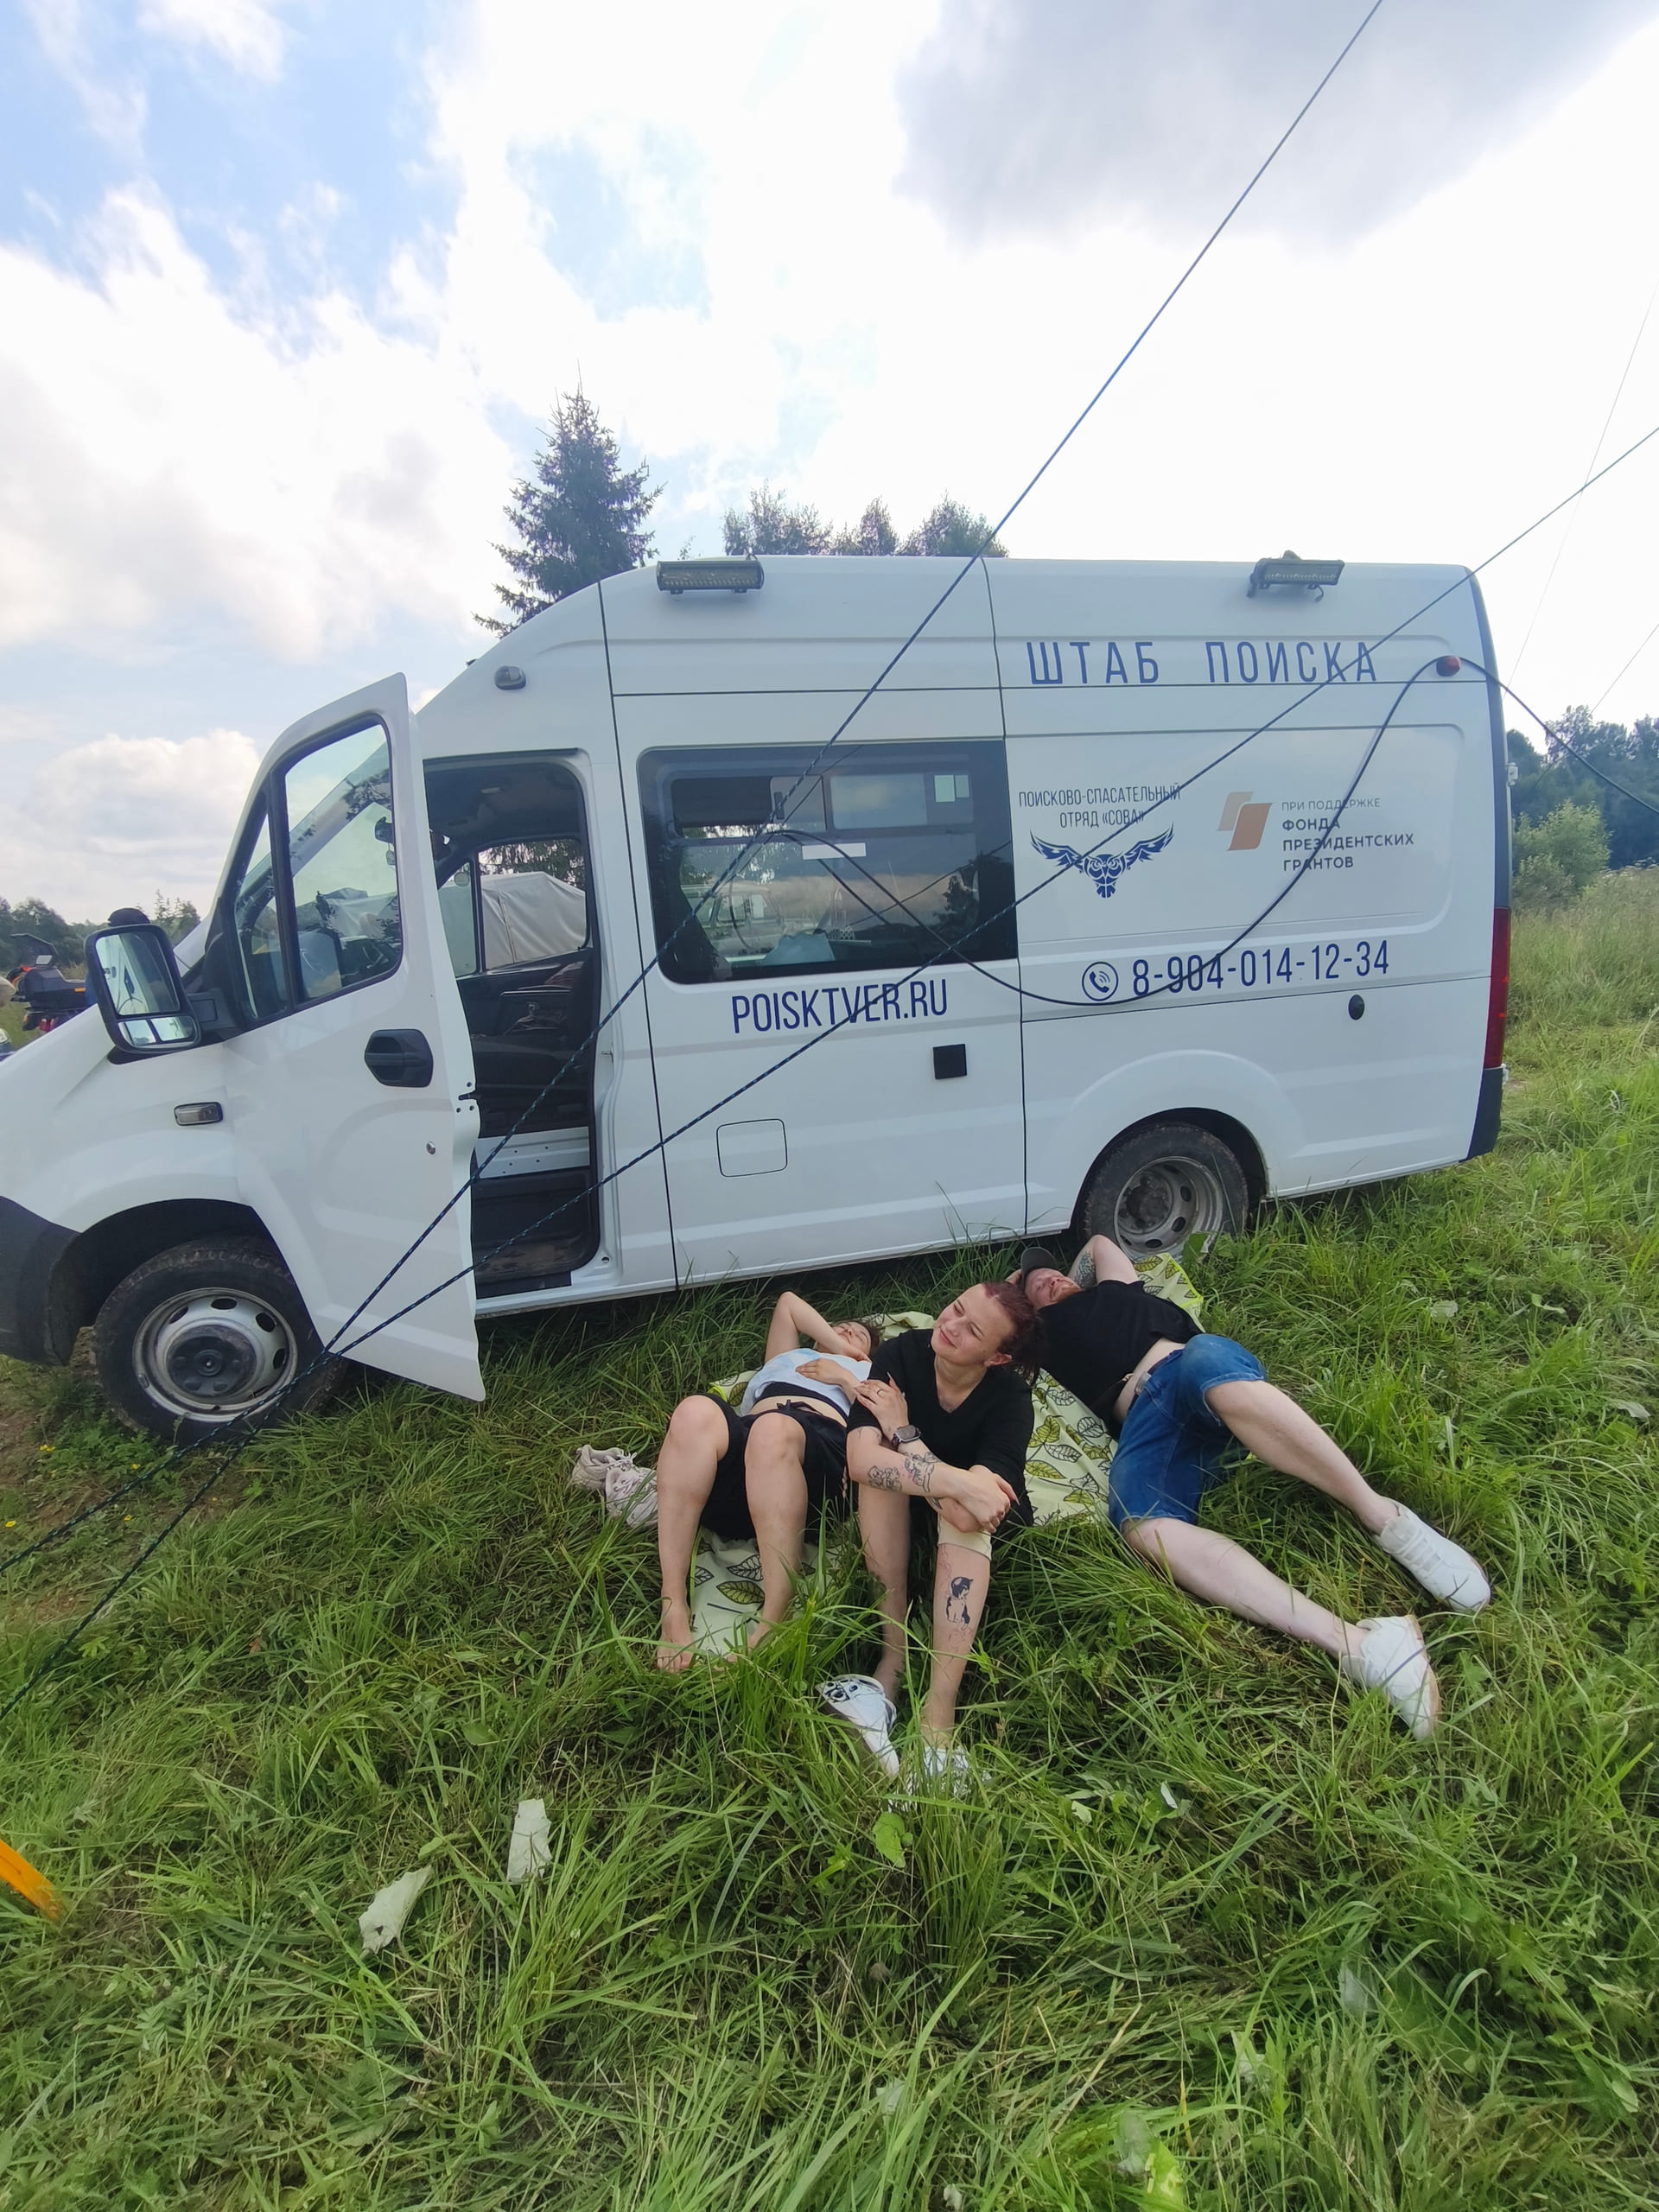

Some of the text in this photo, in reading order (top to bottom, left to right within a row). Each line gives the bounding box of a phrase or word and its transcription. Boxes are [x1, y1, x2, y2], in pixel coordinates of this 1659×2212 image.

[1026, 641, 1377, 684] ШТАБ ПОИСКА
[1019, 782, 1180, 807] ПОИСКОВО-СПАСАТЕЛЬНЫЙ
[1281, 798, 1381, 811] ПРИ ПОДДРЖКЕ
[1059, 810, 1100, 829] ОТРЯД
[1283, 833, 1414, 851] ПРЕЗИДЕНТСКИХ
[1132, 939, 1389, 997] 8-904-014-12-34
[732, 978, 947, 1033] POISKTVER.RU
